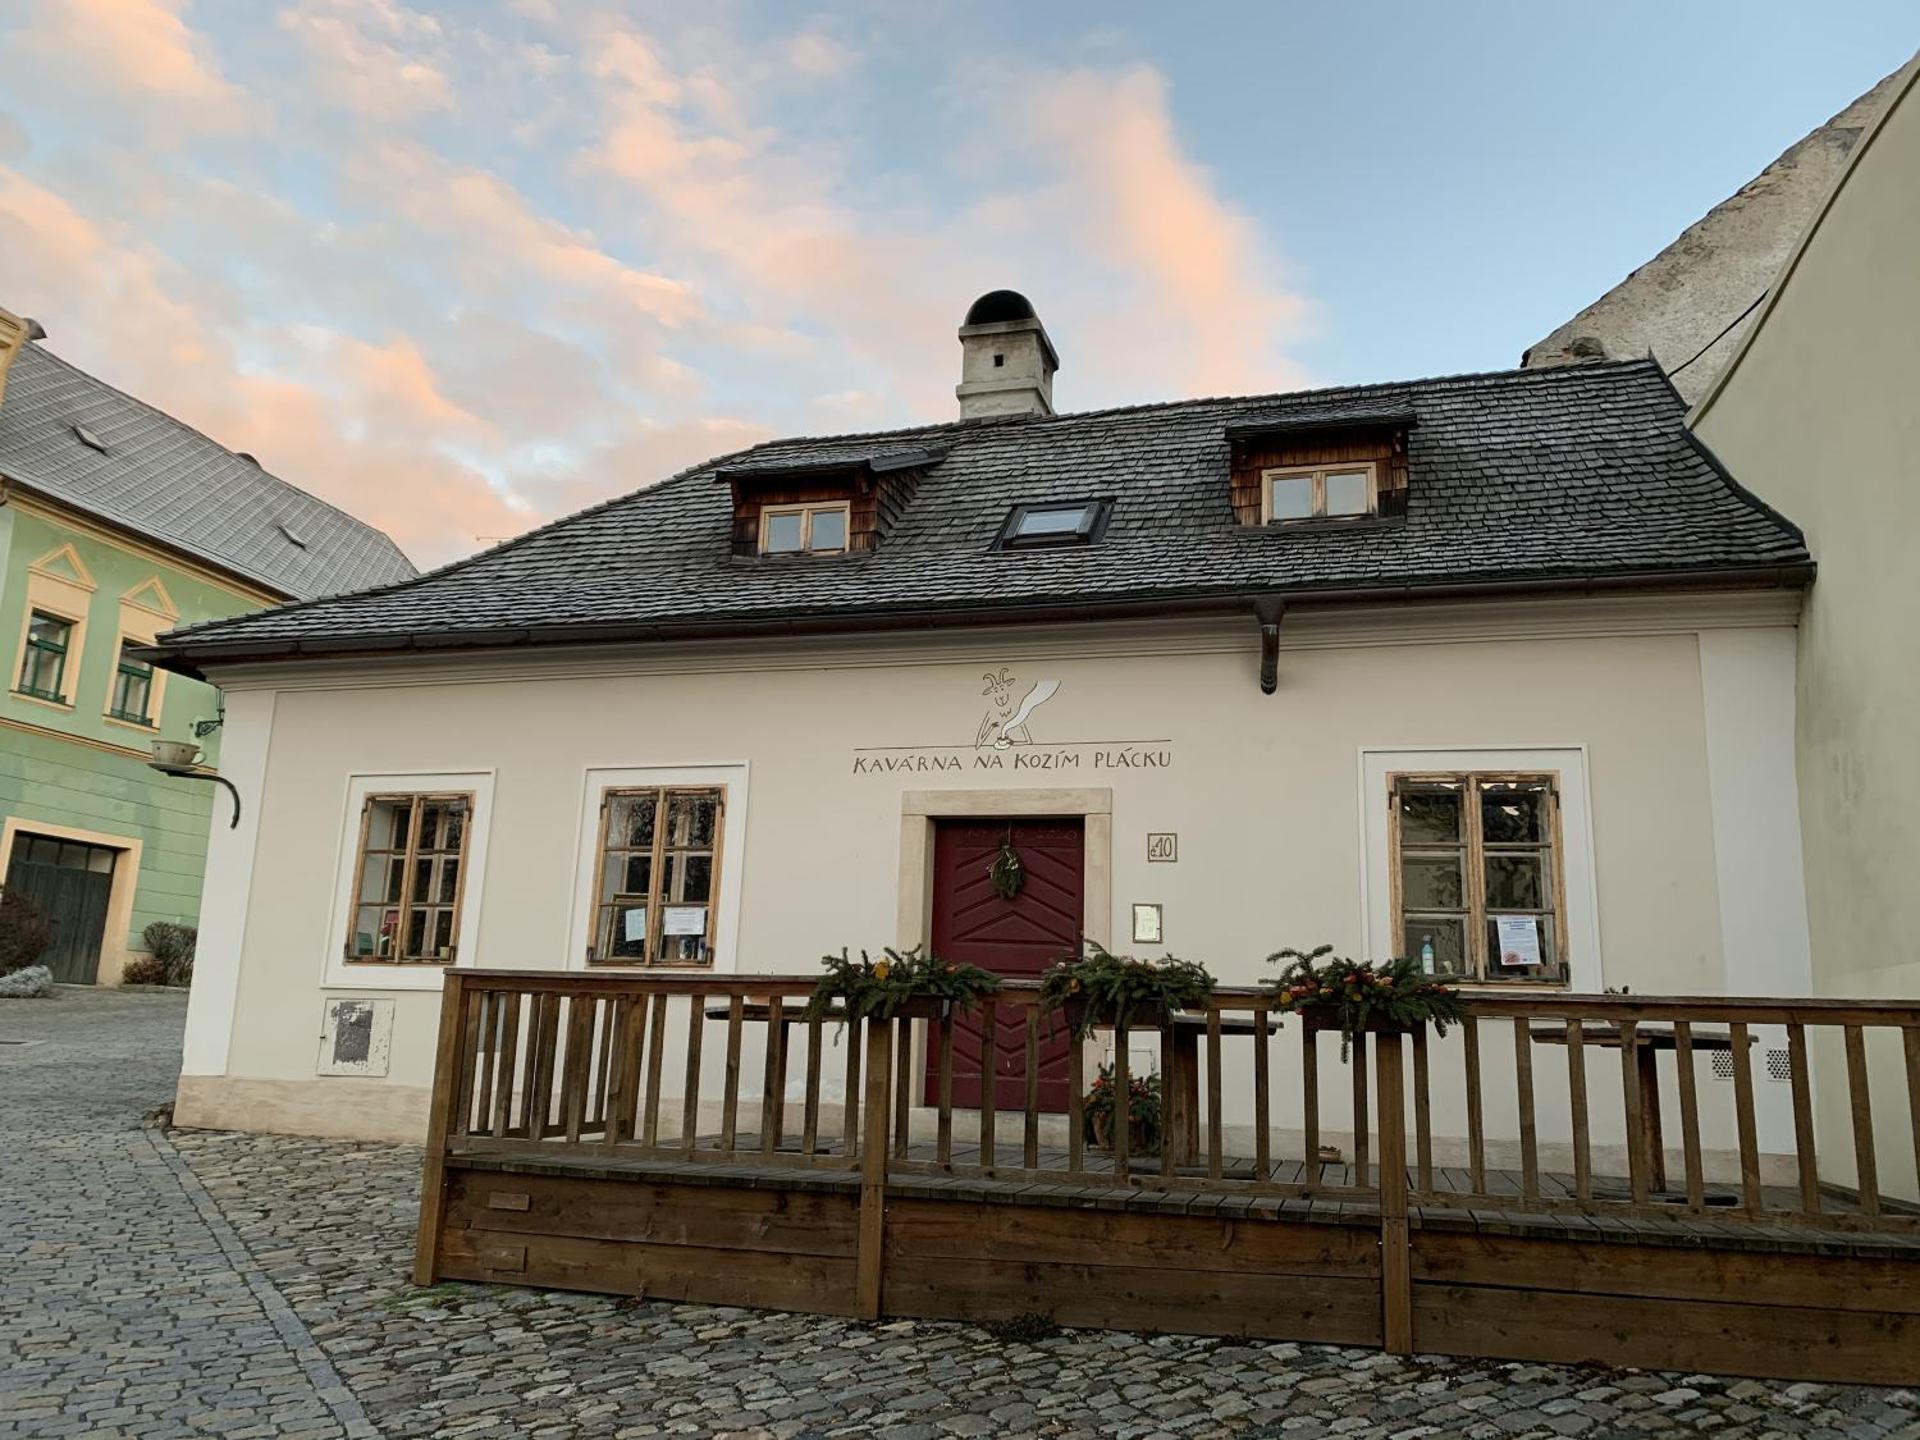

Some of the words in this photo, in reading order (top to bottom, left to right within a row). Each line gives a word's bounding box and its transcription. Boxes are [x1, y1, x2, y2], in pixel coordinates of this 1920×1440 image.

[853, 755, 962, 774] KAVÁRNA
[973, 755, 1003, 769] NA
[1014, 750, 1079, 769] KOZÍM
[1094, 747, 1171, 768] PLÁCKU
